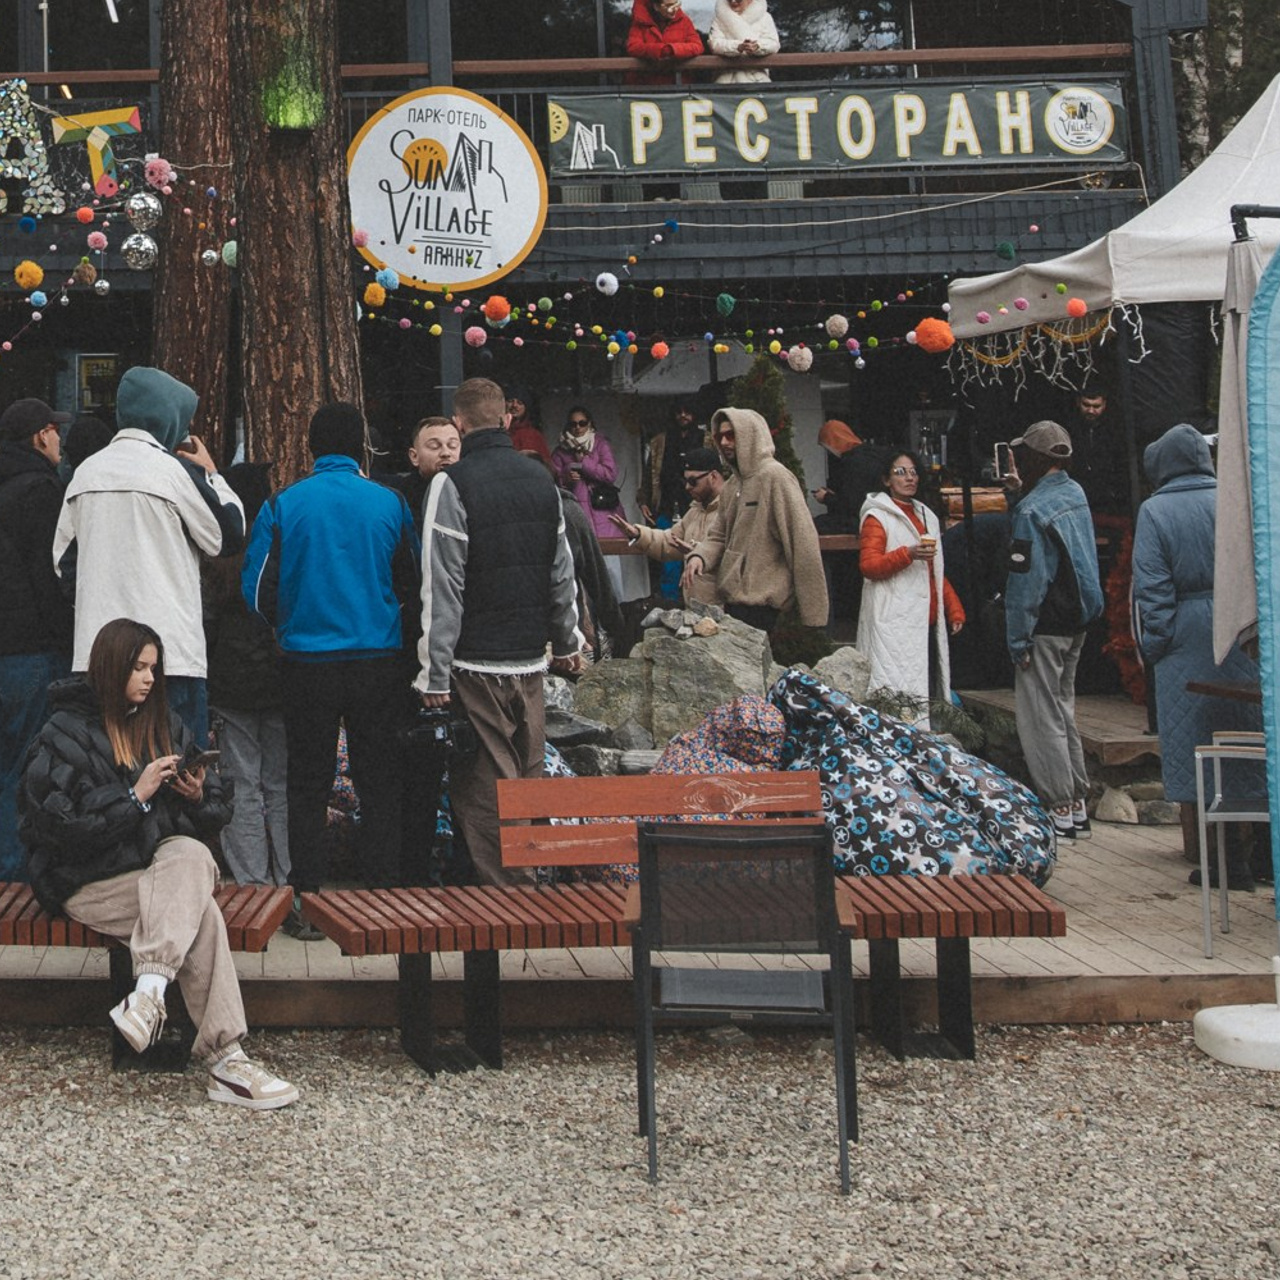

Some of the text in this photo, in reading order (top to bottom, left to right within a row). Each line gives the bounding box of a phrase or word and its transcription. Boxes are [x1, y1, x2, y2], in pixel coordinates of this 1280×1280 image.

[407, 107, 488, 130] ПАРК-ОТЕЛЬ
[629, 89, 1035, 165] РЕСТОРАН
[423, 245, 483, 269] ARKHYZ
